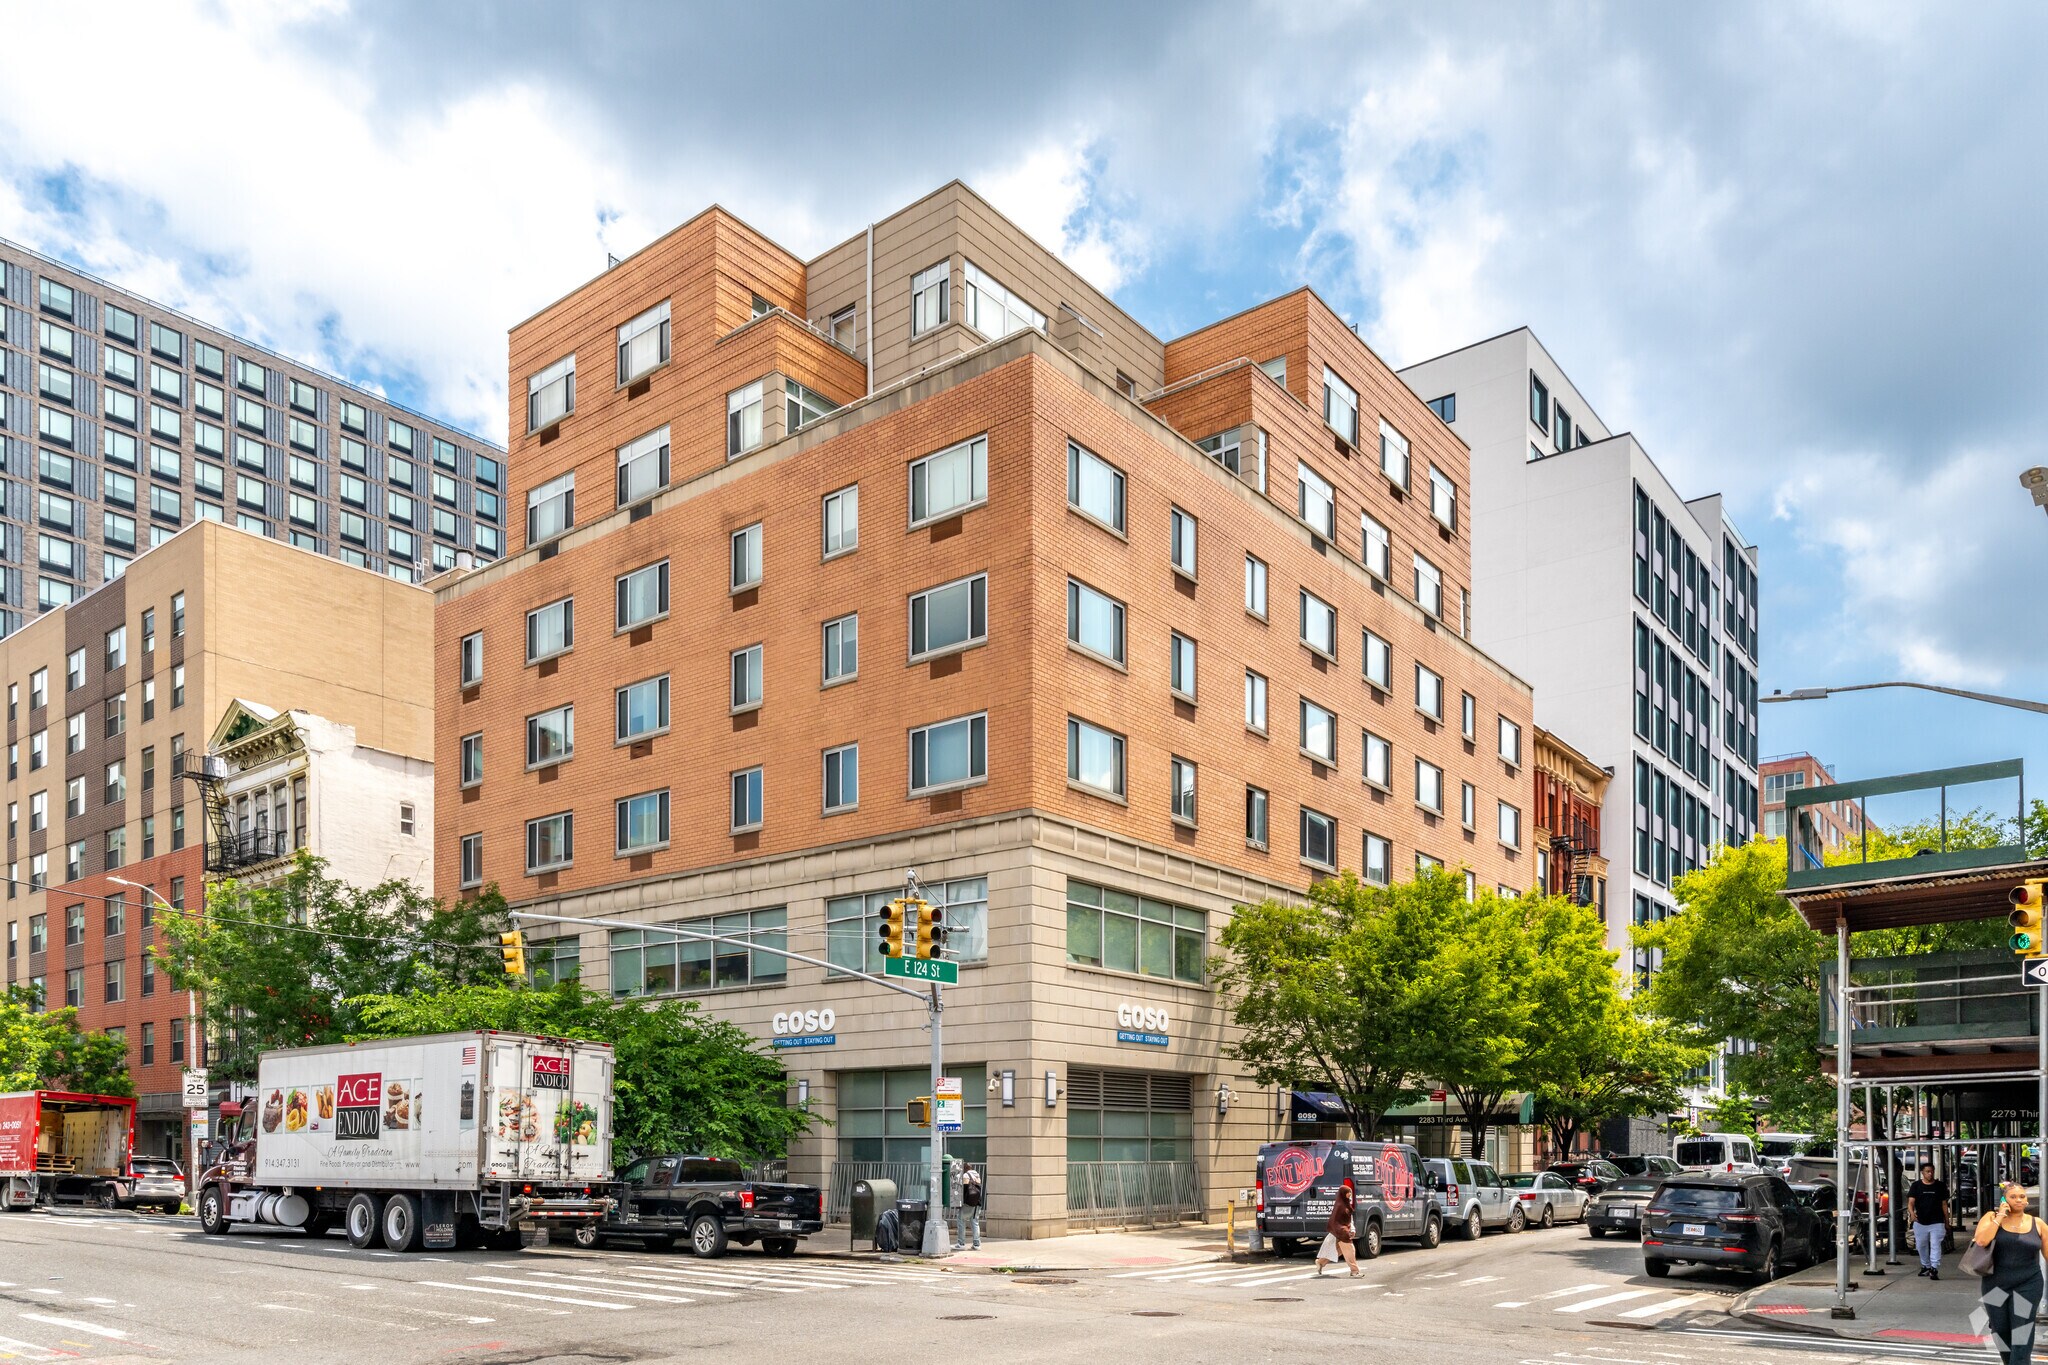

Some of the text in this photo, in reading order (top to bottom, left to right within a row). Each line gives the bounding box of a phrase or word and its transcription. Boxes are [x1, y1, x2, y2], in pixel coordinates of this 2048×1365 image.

[904, 960, 940, 978] E 124 St
[772, 1008, 836, 1035] GOSO
[1117, 1003, 1169, 1032] GOSO
[1119, 1032, 1135, 1041] GETTING
[1136, 1034, 1144, 1042] OUT
[535, 1058, 568, 1073] ACE
[534, 1073, 569, 1087] ENDICO
[186, 1083, 205, 1095] 25
[338, 1078, 379, 1103] ACE
[1418, 1116, 1435, 1124] 2283
[1991, 1109, 2040, 1118] 2279 Thir
[337, 1109, 379, 1135] ENDICO
[327, 1143, 393, 1159] A Family Tradition
[264, 1158, 300, 1168] 914.347.3131
[1265, 1163, 1294, 1187] EXIT
[1294, 1156, 1325, 1181] MOLD
